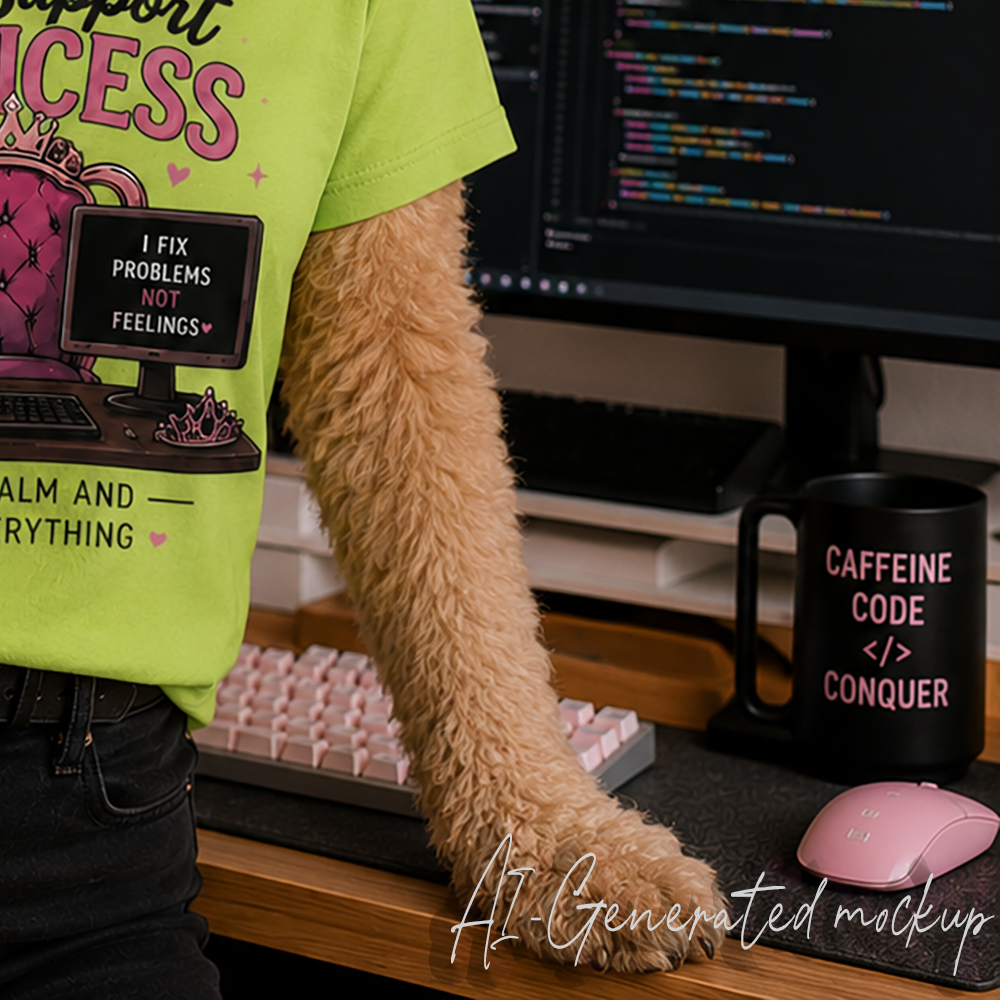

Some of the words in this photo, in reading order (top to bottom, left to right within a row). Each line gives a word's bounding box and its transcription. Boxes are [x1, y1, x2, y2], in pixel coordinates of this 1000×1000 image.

[142, 234, 149, 254] I
[156, 236, 189, 256] FIX
[112, 259, 211, 287] PROBLEMS
[141, 288, 180, 309] NOT
[112, 311, 200, 337] FEELINGS
[73, 480, 134, 509] AND
[825, 544, 953, 584] CAFFEINE
[851, 592, 925, 627] CODE
[823, 670, 949, 711] CONQUER
